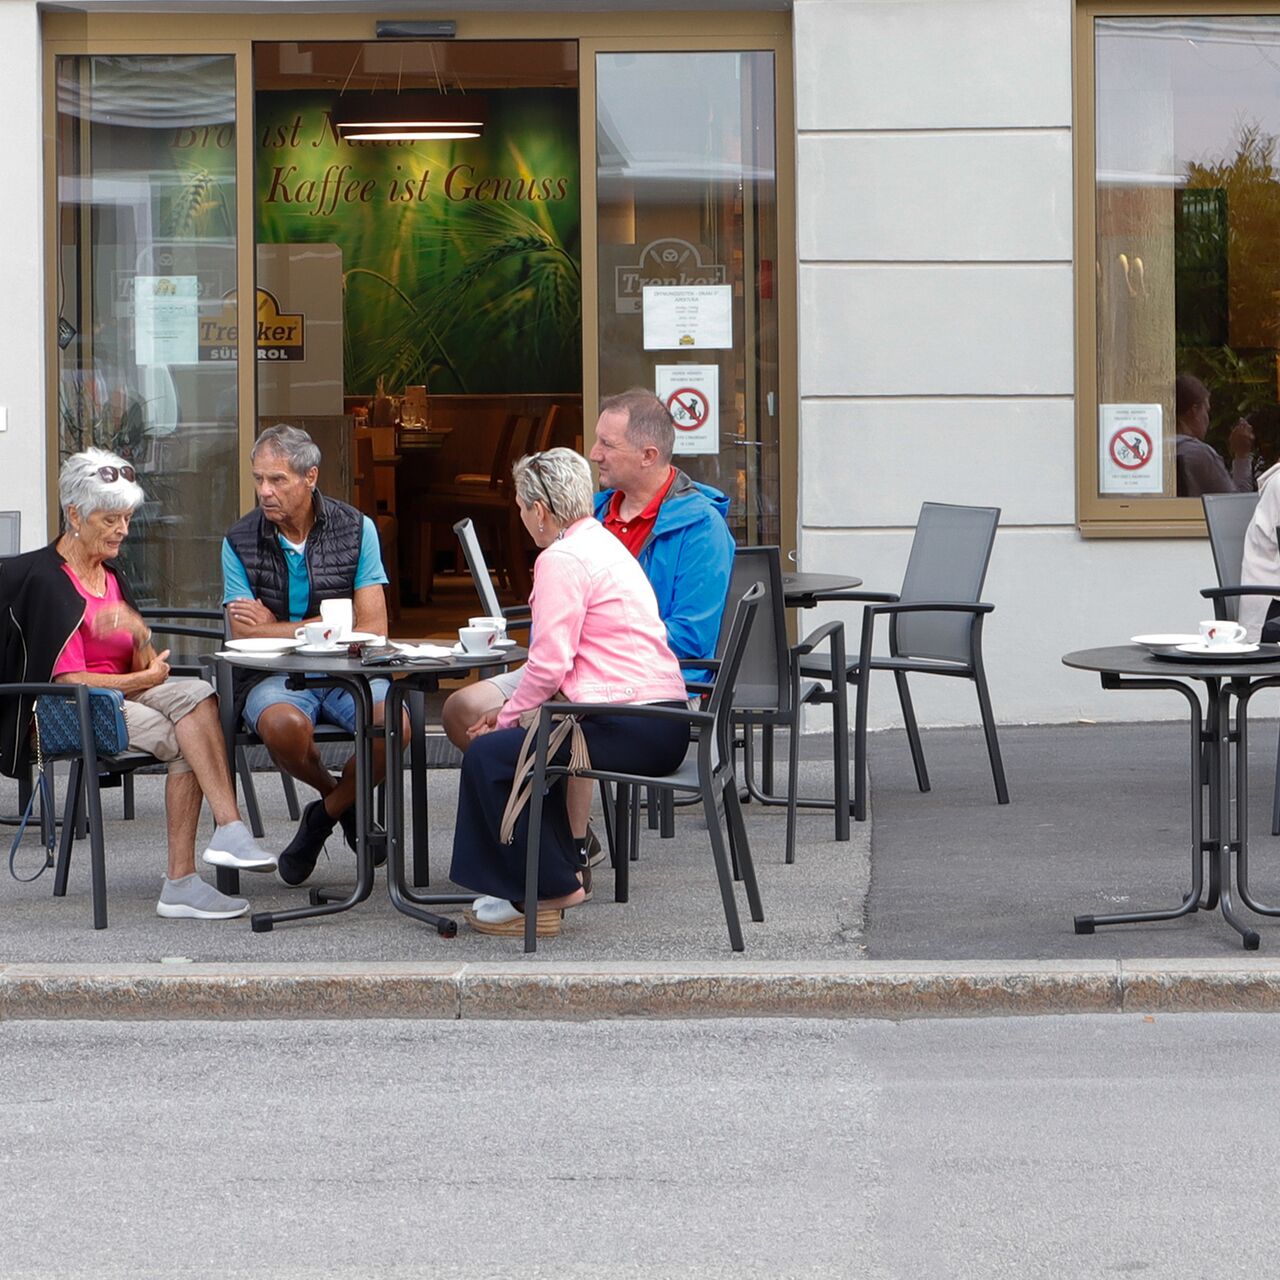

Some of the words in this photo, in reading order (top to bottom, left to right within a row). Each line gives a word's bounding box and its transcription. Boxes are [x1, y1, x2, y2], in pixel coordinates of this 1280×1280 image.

[170, 125, 233, 148] Bro
[262, 115, 303, 148] ist
[264, 165, 376, 217] Kaffee
[388, 165, 431, 202] ist
[444, 164, 569, 202] Genuss
[203, 322, 297, 341] Treker
